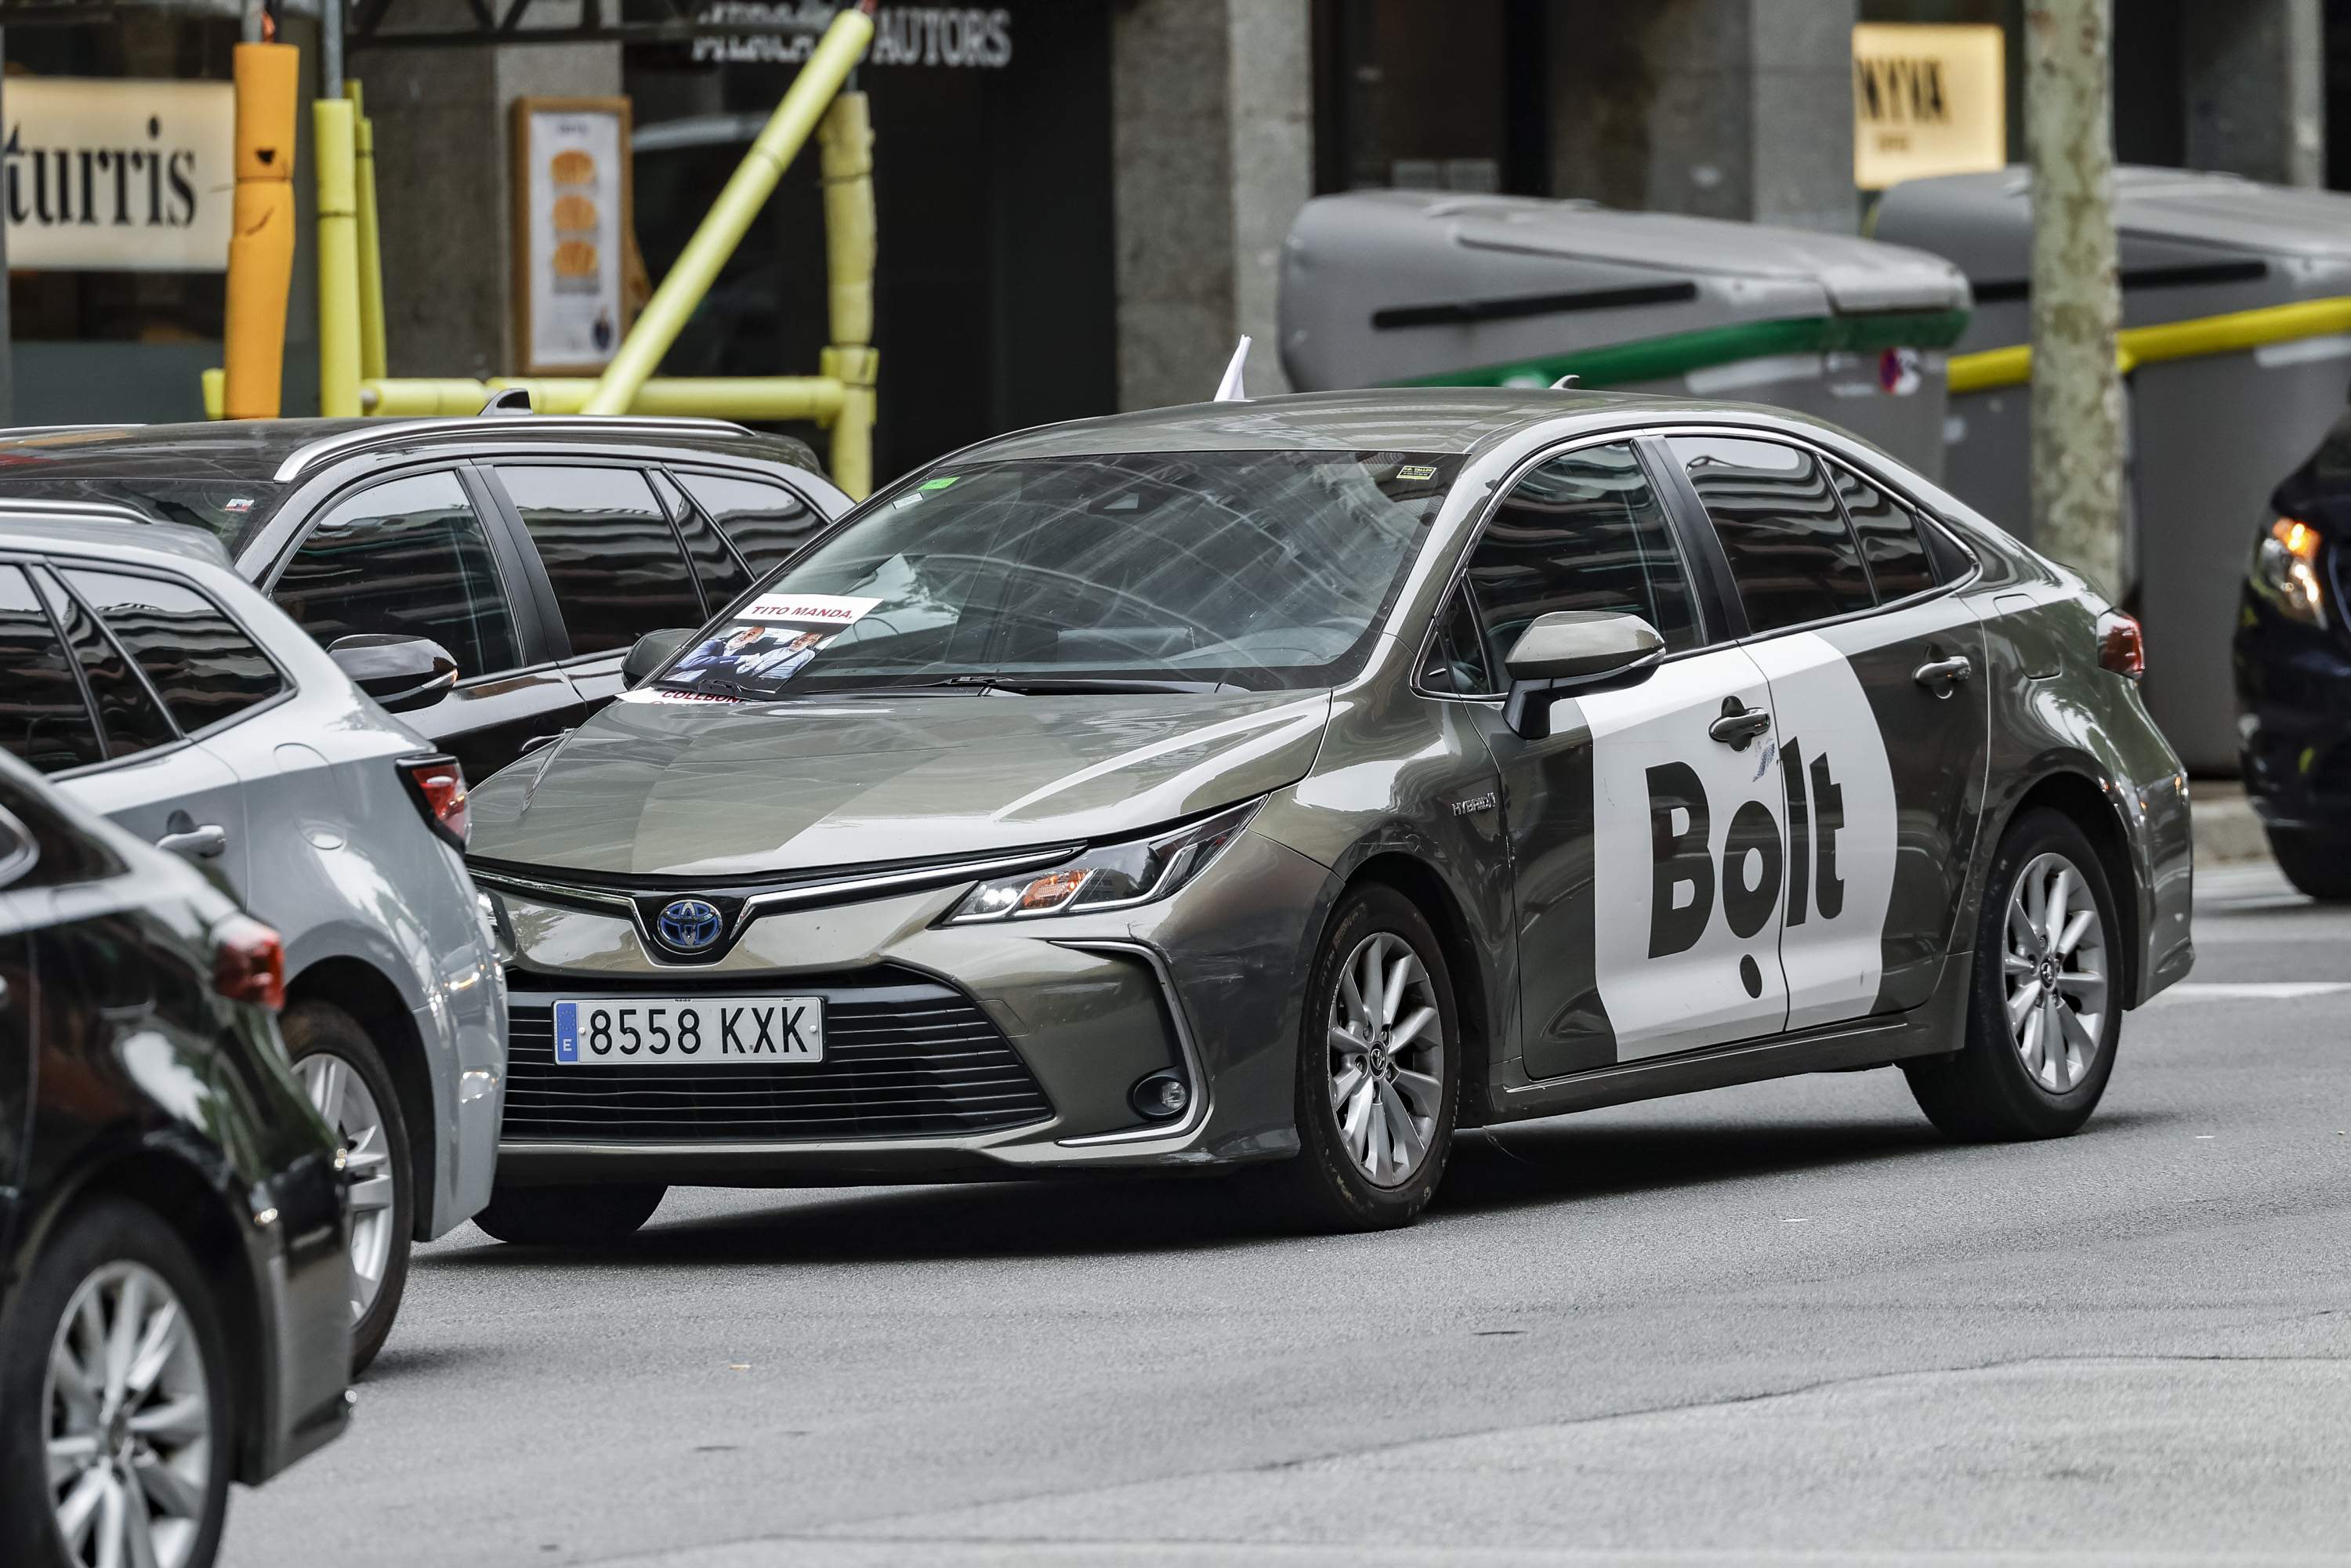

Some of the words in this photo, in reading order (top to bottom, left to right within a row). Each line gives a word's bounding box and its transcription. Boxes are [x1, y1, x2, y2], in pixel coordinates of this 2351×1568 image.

[5, 114, 197, 227] turris
[751, 606, 790, 615] TITO
[791, 607, 853, 620] MANDA,
[1645, 735, 1845, 960] Bolt
[563, 1038, 572, 1052] E
[589, 1008, 701, 1056] 8558
[720, 1006, 809, 1054] KXK
